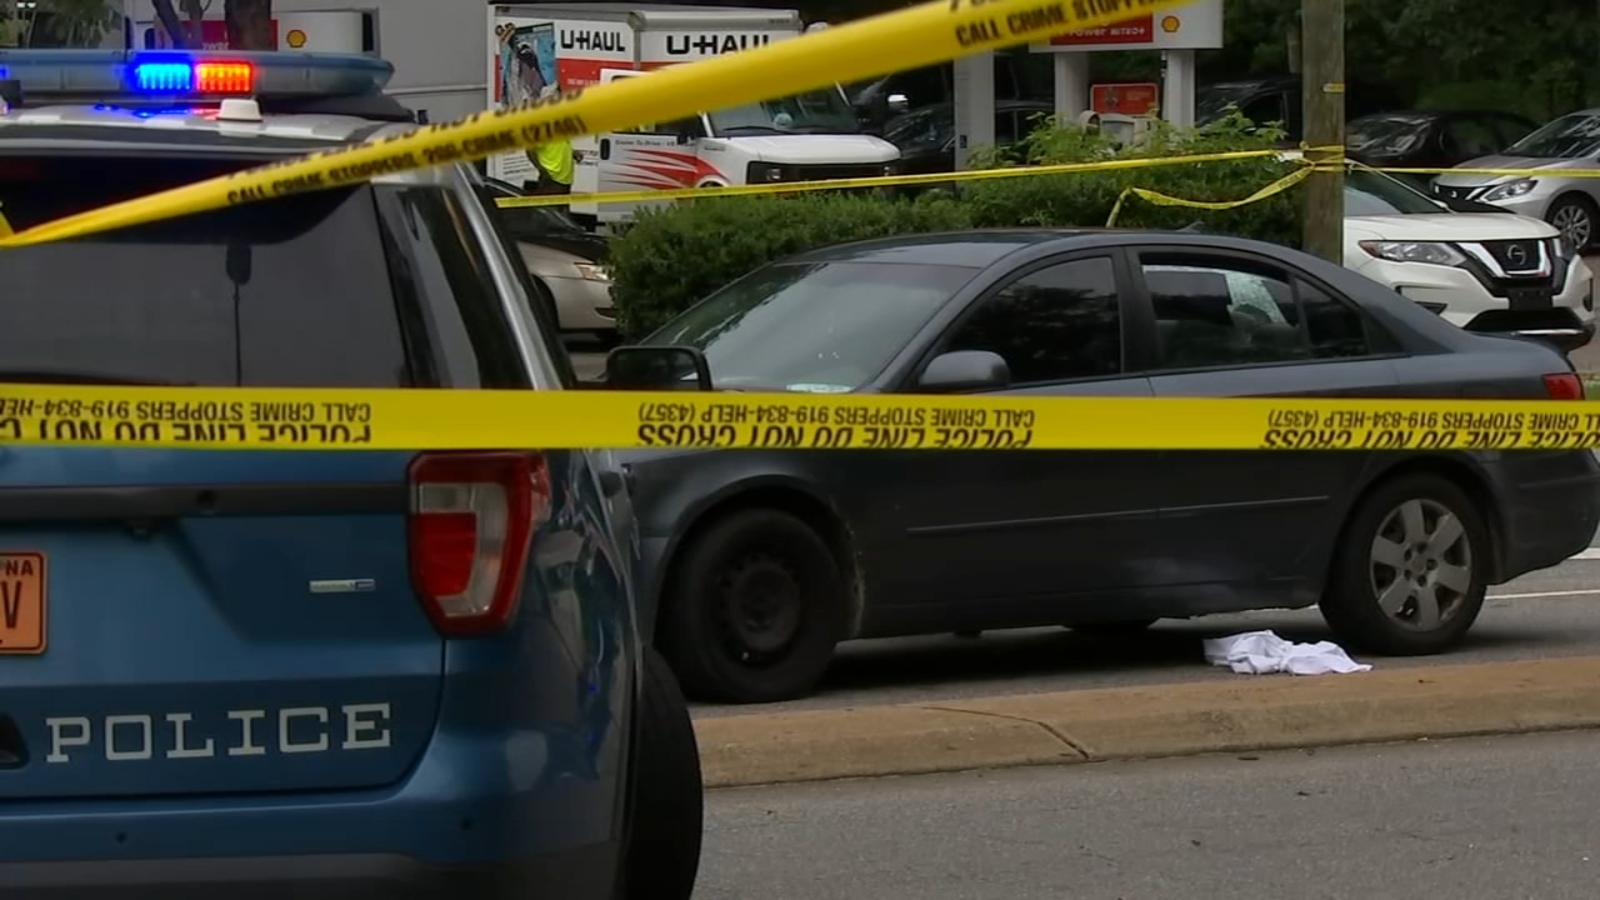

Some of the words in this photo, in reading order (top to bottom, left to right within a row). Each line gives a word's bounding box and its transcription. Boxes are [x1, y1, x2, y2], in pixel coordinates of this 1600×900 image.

[955, 18, 1001, 47] CALL
[1006, 3, 1066, 35] CRIME
[560, 29, 626, 52] U-HAUL
[227, 184, 266, 205] CALL
[0, 398, 130, 419] 919-834-HEL
[136, 401, 243, 421] STOPPERS
[250, 401, 315, 422] CRIME
[321, 401, 371, 422] CALL
[638, 402, 696, 422] (4357)
[701, 403, 830, 424] 919-834-HELP
[834, 405, 927, 427] STOPPERS
[930, 408, 987, 428] CRIME
[992, 408, 1036, 429] CALL
[1267, 408, 1320, 429] (4357)
[1323, 409, 1439, 429] 919-834-HELP
[1441, 410, 1525, 430] STOPPERS
[1527, 411, 1581, 431] CRIME
[1527, 430, 1600, 449] OLICE
[45, 702, 391, 763] POLICE
